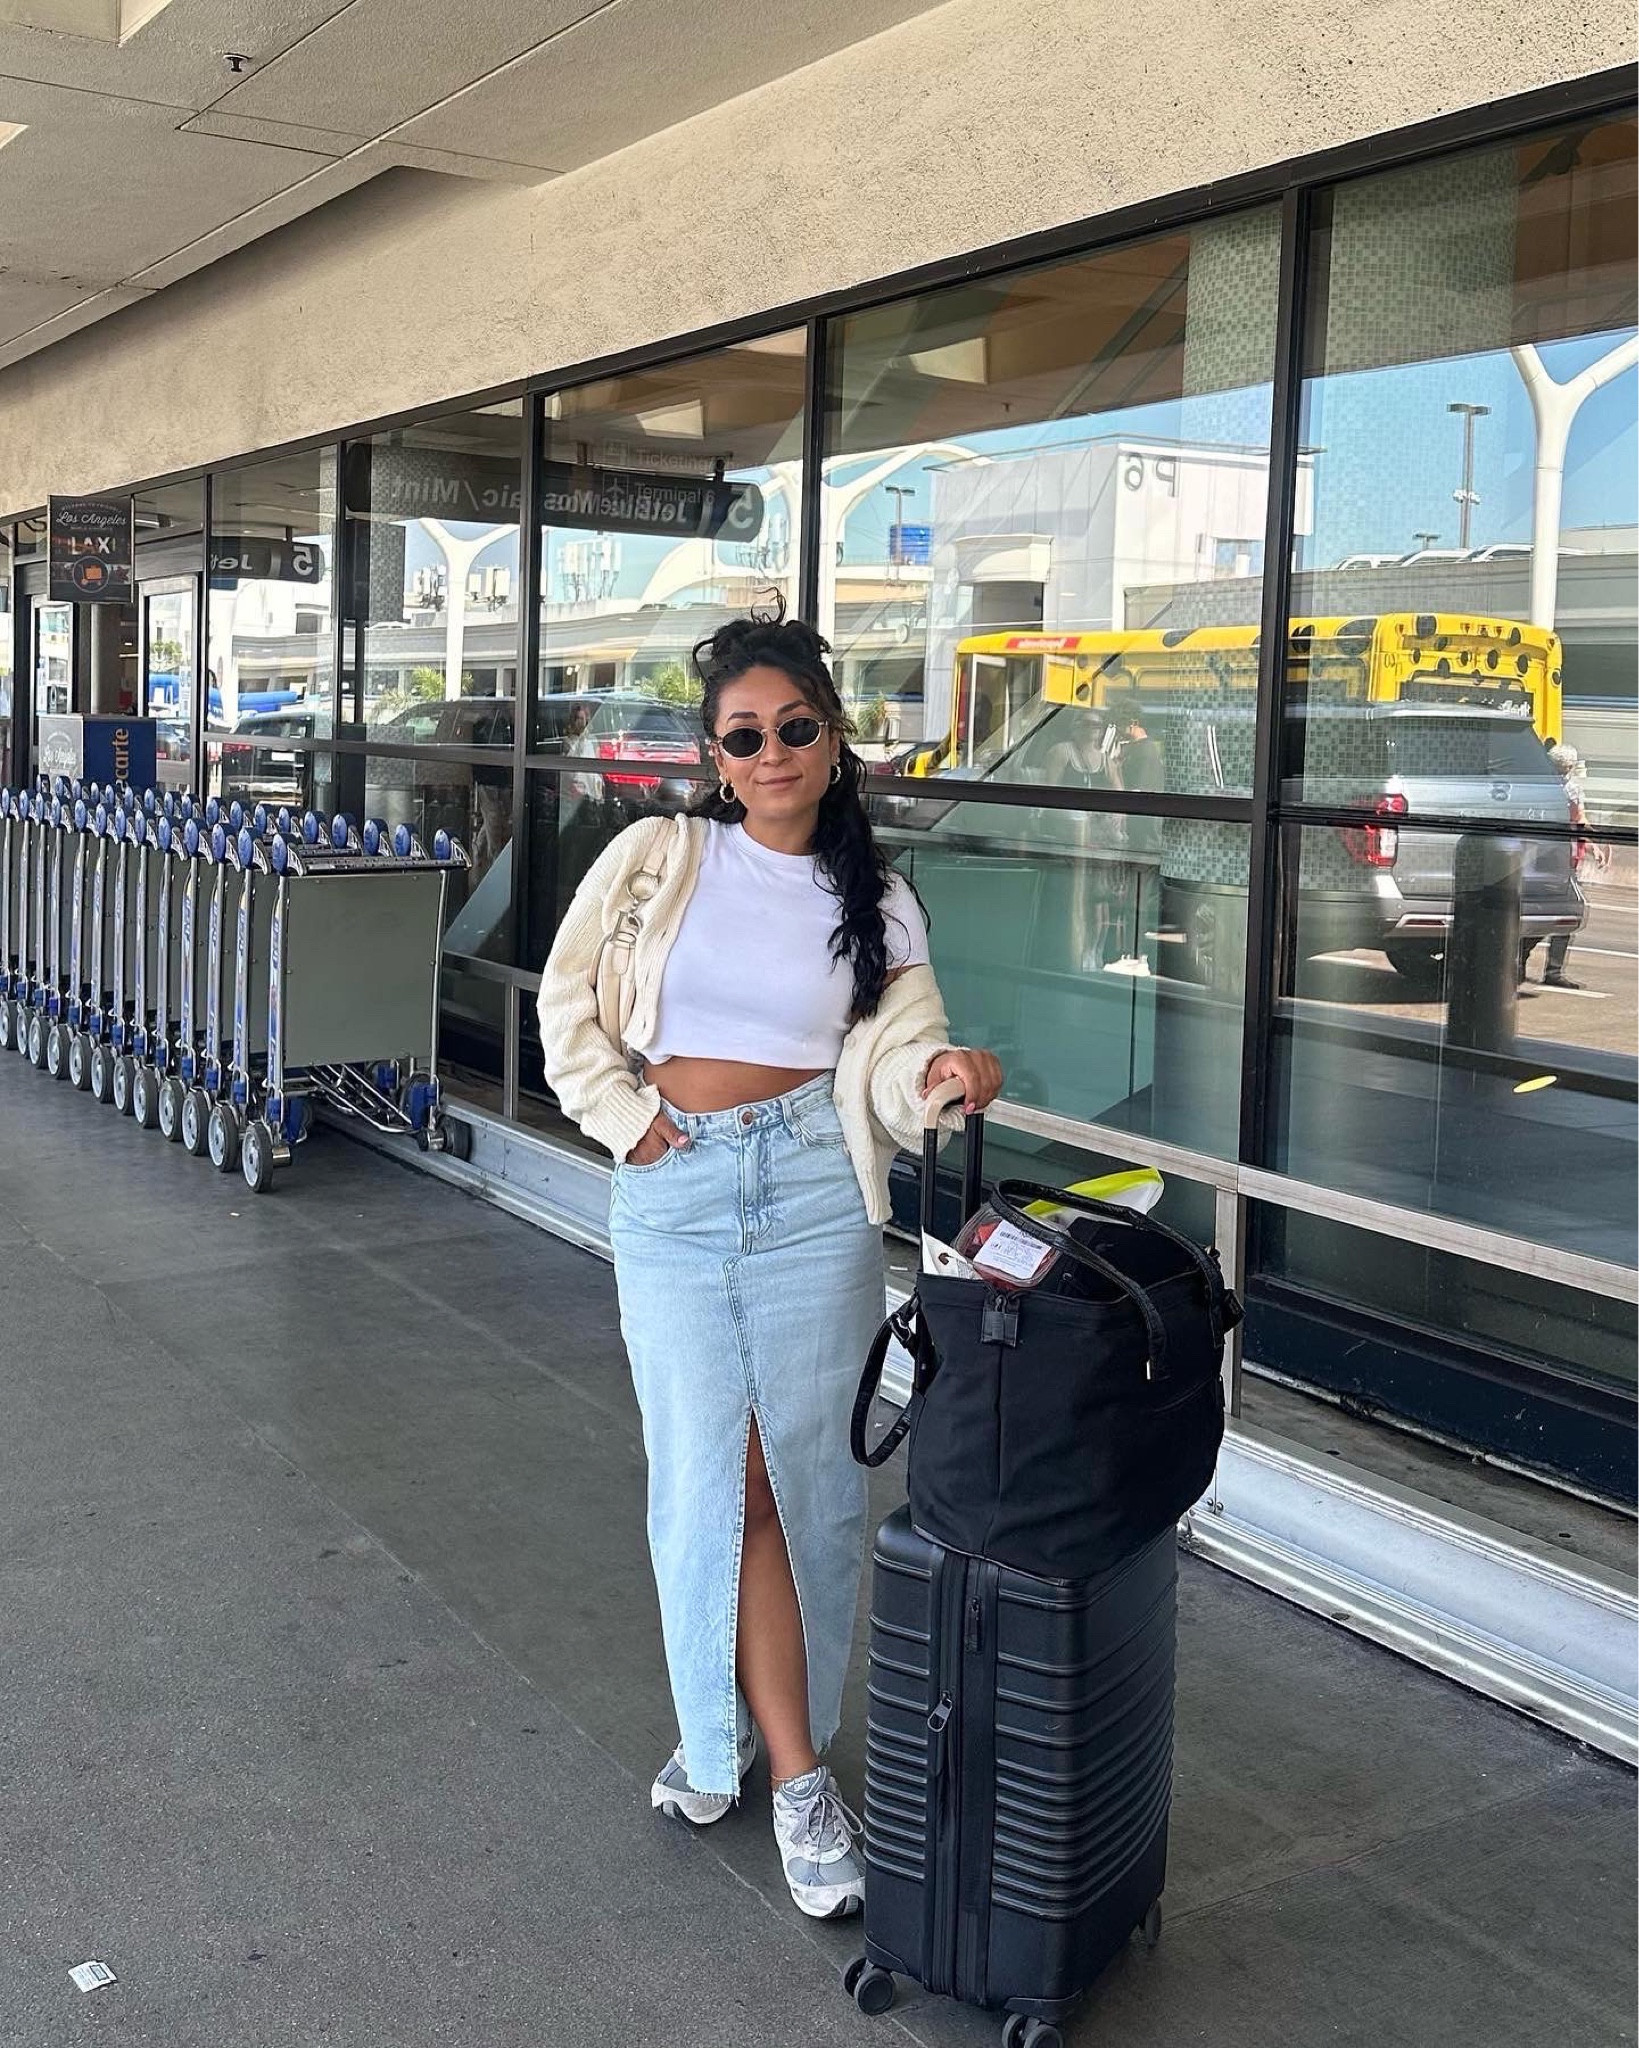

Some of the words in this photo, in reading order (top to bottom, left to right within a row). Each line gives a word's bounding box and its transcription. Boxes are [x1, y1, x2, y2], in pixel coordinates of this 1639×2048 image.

[634, 481, 701, 504] Terminal
[56, 511, 78, 526] Los
[81, 513, 127, 529] Angeles
